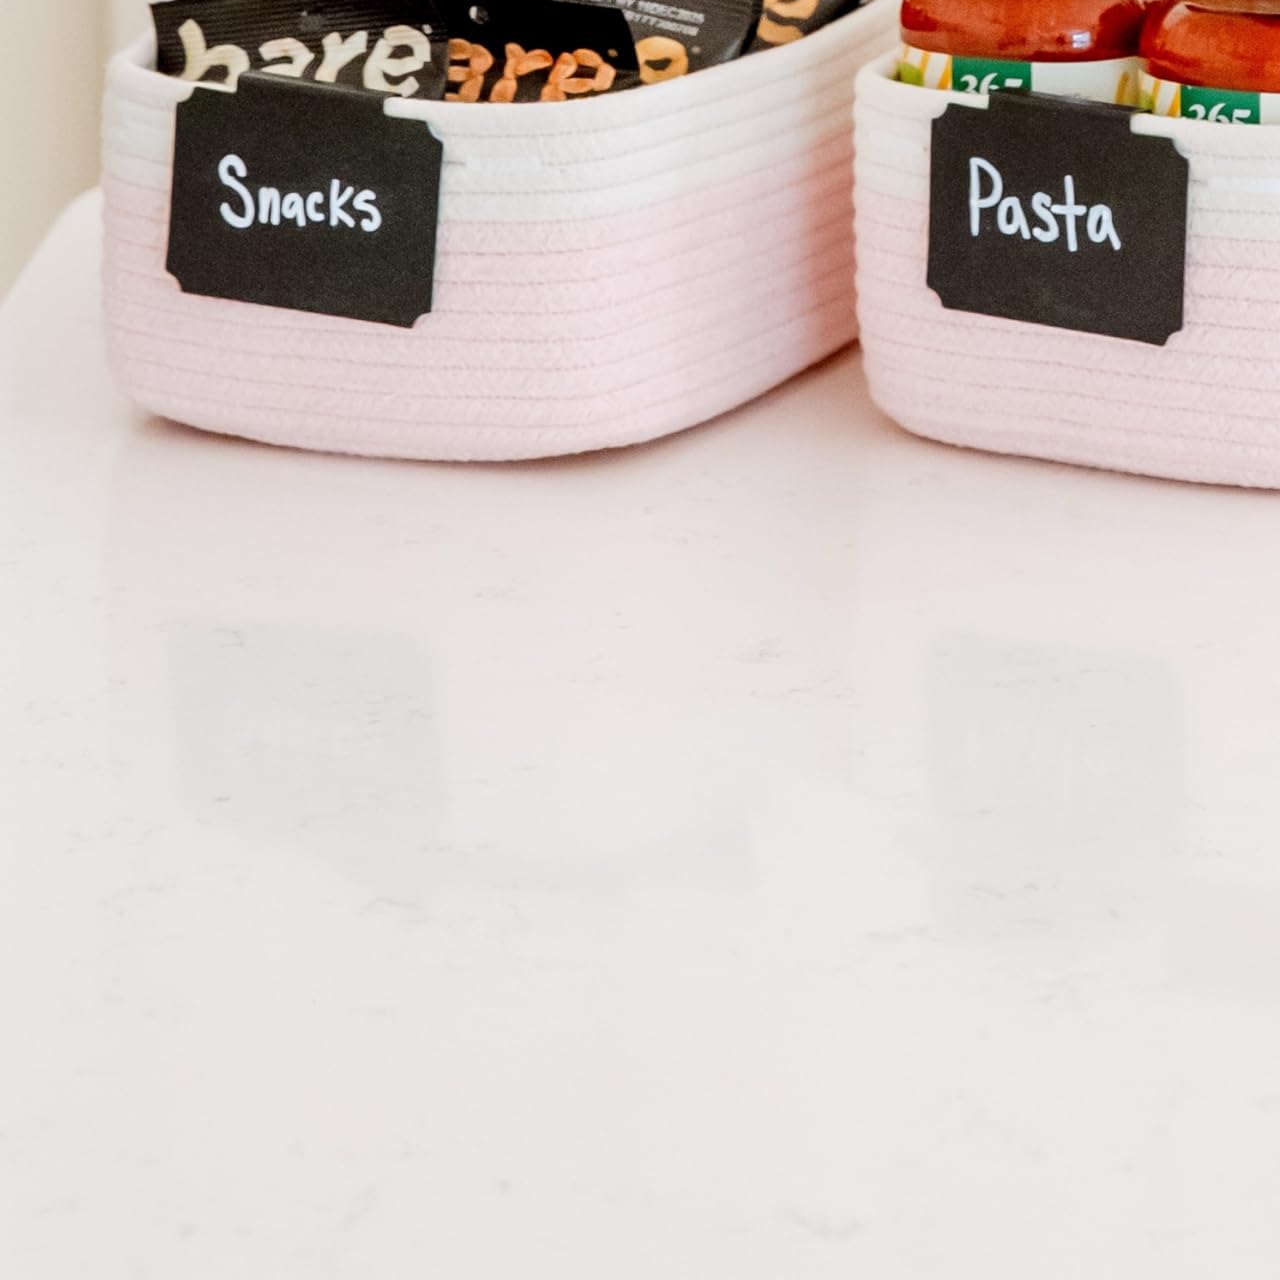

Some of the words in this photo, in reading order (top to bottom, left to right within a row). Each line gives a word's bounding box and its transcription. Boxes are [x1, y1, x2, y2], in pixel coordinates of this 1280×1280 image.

[445, 37, 617, 103] are
[218, 153, 382, 233] Snacks
[969, 156, 1122, 253] Pasta
